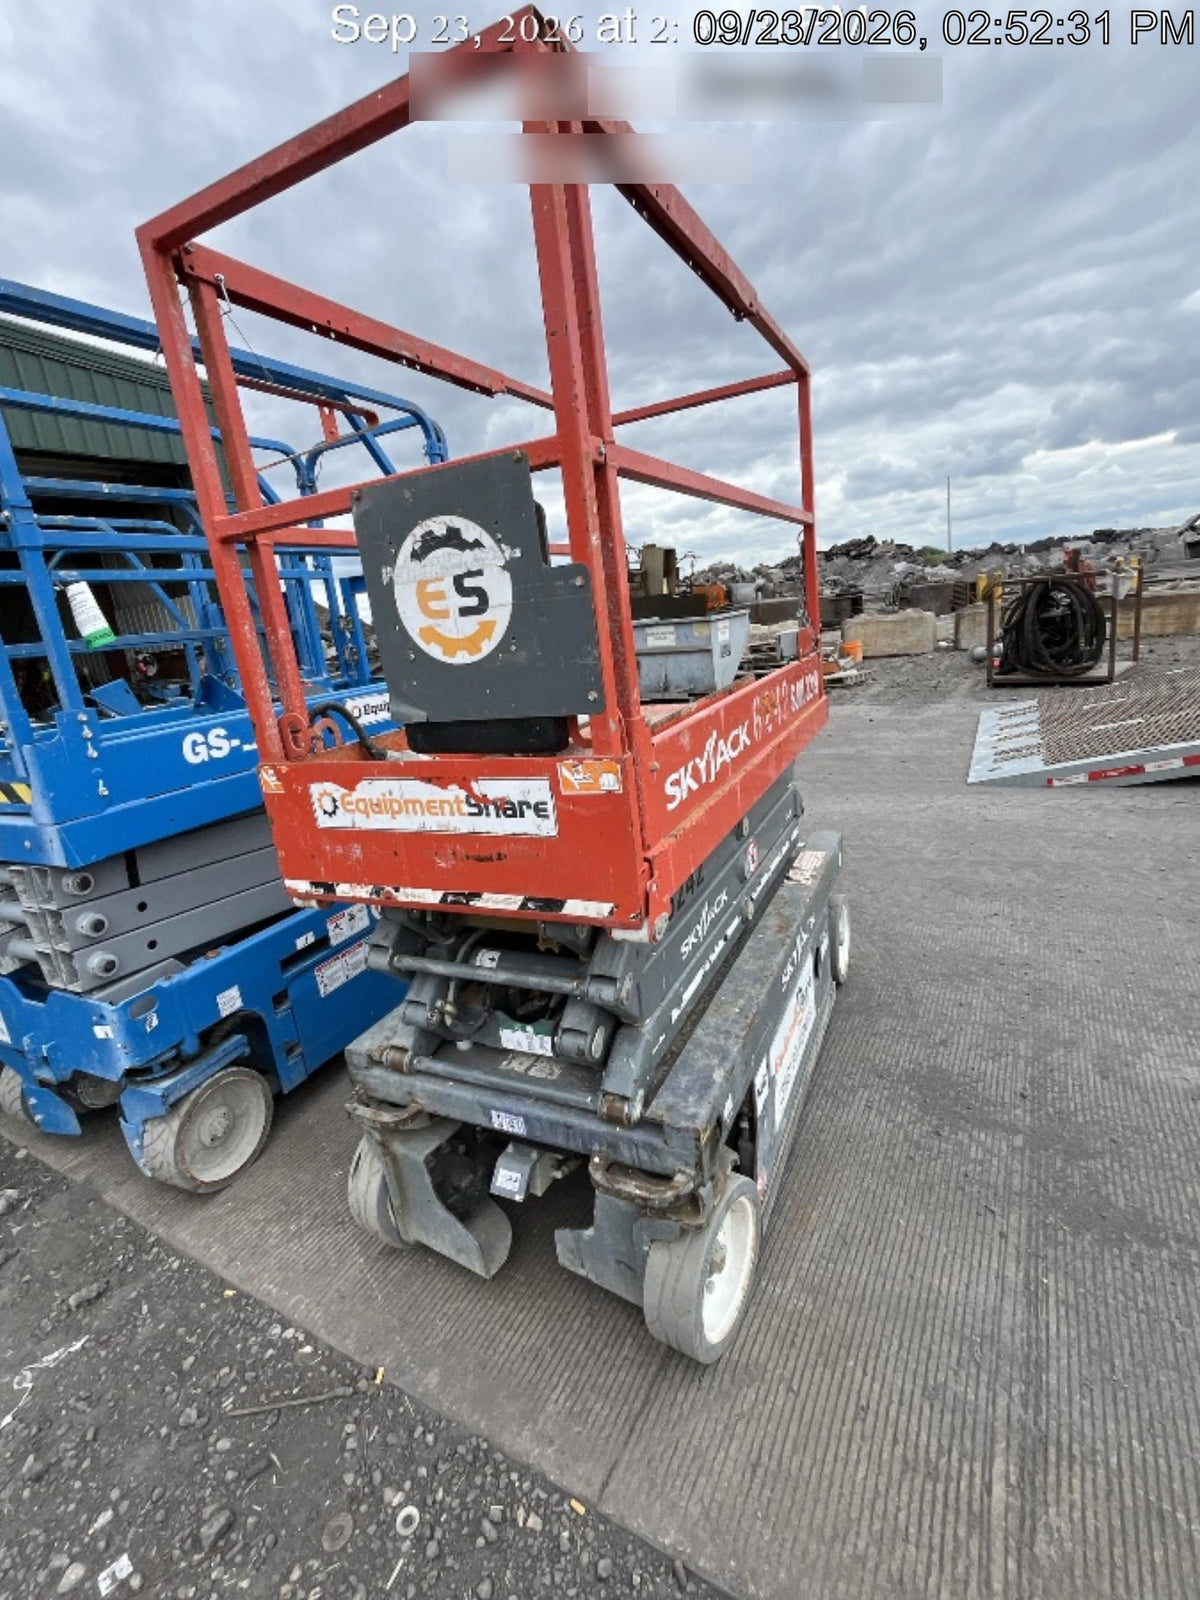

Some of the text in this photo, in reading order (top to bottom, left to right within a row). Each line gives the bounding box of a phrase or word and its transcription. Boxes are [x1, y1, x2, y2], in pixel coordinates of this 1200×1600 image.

[416, 568, 490, 620] ES
[664, 720, 751, 811] SKYJACK
[680, 887, 728, 960] SKYJACK
